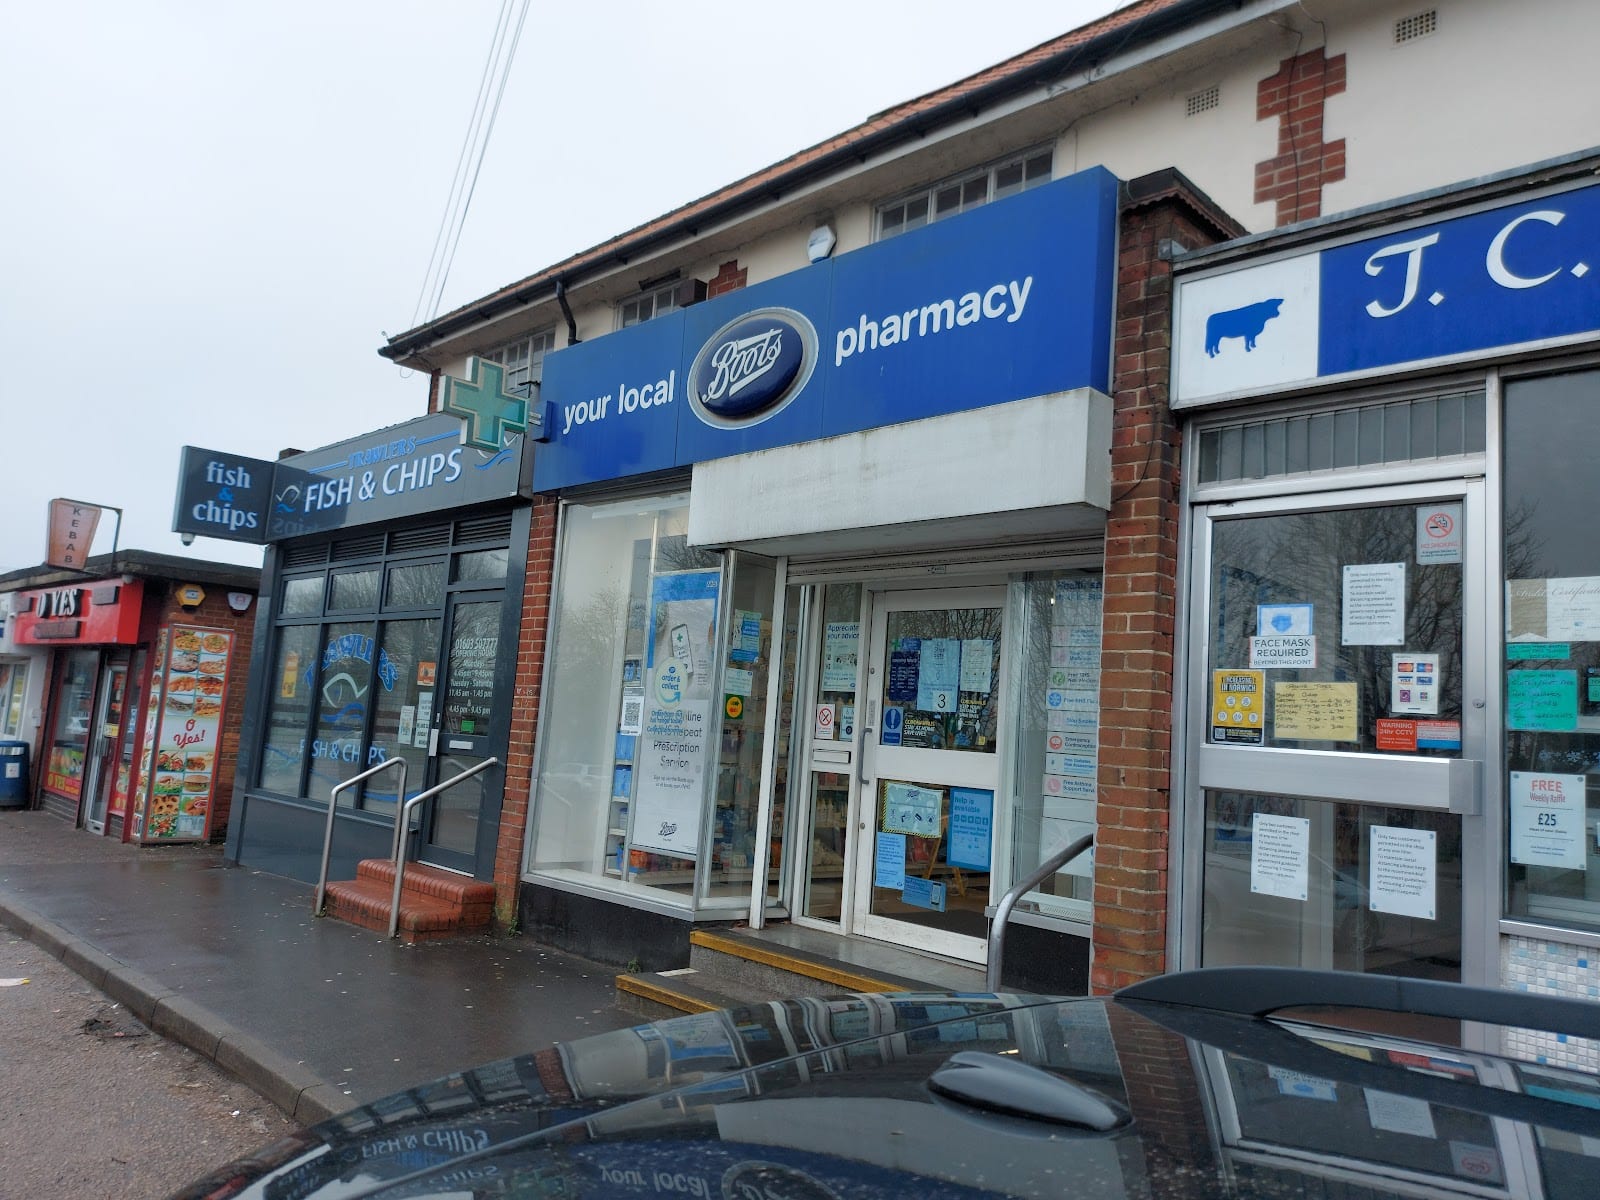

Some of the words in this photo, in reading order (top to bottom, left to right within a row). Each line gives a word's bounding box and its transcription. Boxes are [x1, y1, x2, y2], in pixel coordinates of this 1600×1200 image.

[1363, 231, 1444, 319] J.
[1485, 209, 1590, 290] C.
[833, 275, 1035, 368] pharmacy
[702, 326, 783, 404] Boots
[562, 390, 612, 436] your
[617, 369, 676, 416] local
[347, 435, 418, 469] TRAWLERS
[206, 460, 251, 489] fish
[304, 475, 353, 513] FISH
[358, 469, 377, 501] &
[382, 448, 464, 496] CHIPS
[192, 501, 258, 531] chips
[51, 588, 79, 618] YES
[1254, 639, 1280, 648] FACE
[1282, 638, 1311, 647] MASK
[1256, 648, 1309, 657] REQUIRED
[937, 693, 946, 709] 3
[185, 719, 196, 731] O
[1395, 728, 1414, 736] CCTV
[173, 729, 206, 749] Yes!
[654, 740, 700, 755] Prescription
[329, 740, 340, 760] &
[342, 743, 386, 765] CHPS
[660, 756, 690, 769] Service
[1531, 780, 1563, 793] FREE
[1530, 792, 1549, 804] Weekly
[1538, 813, 1557, 826] £25
